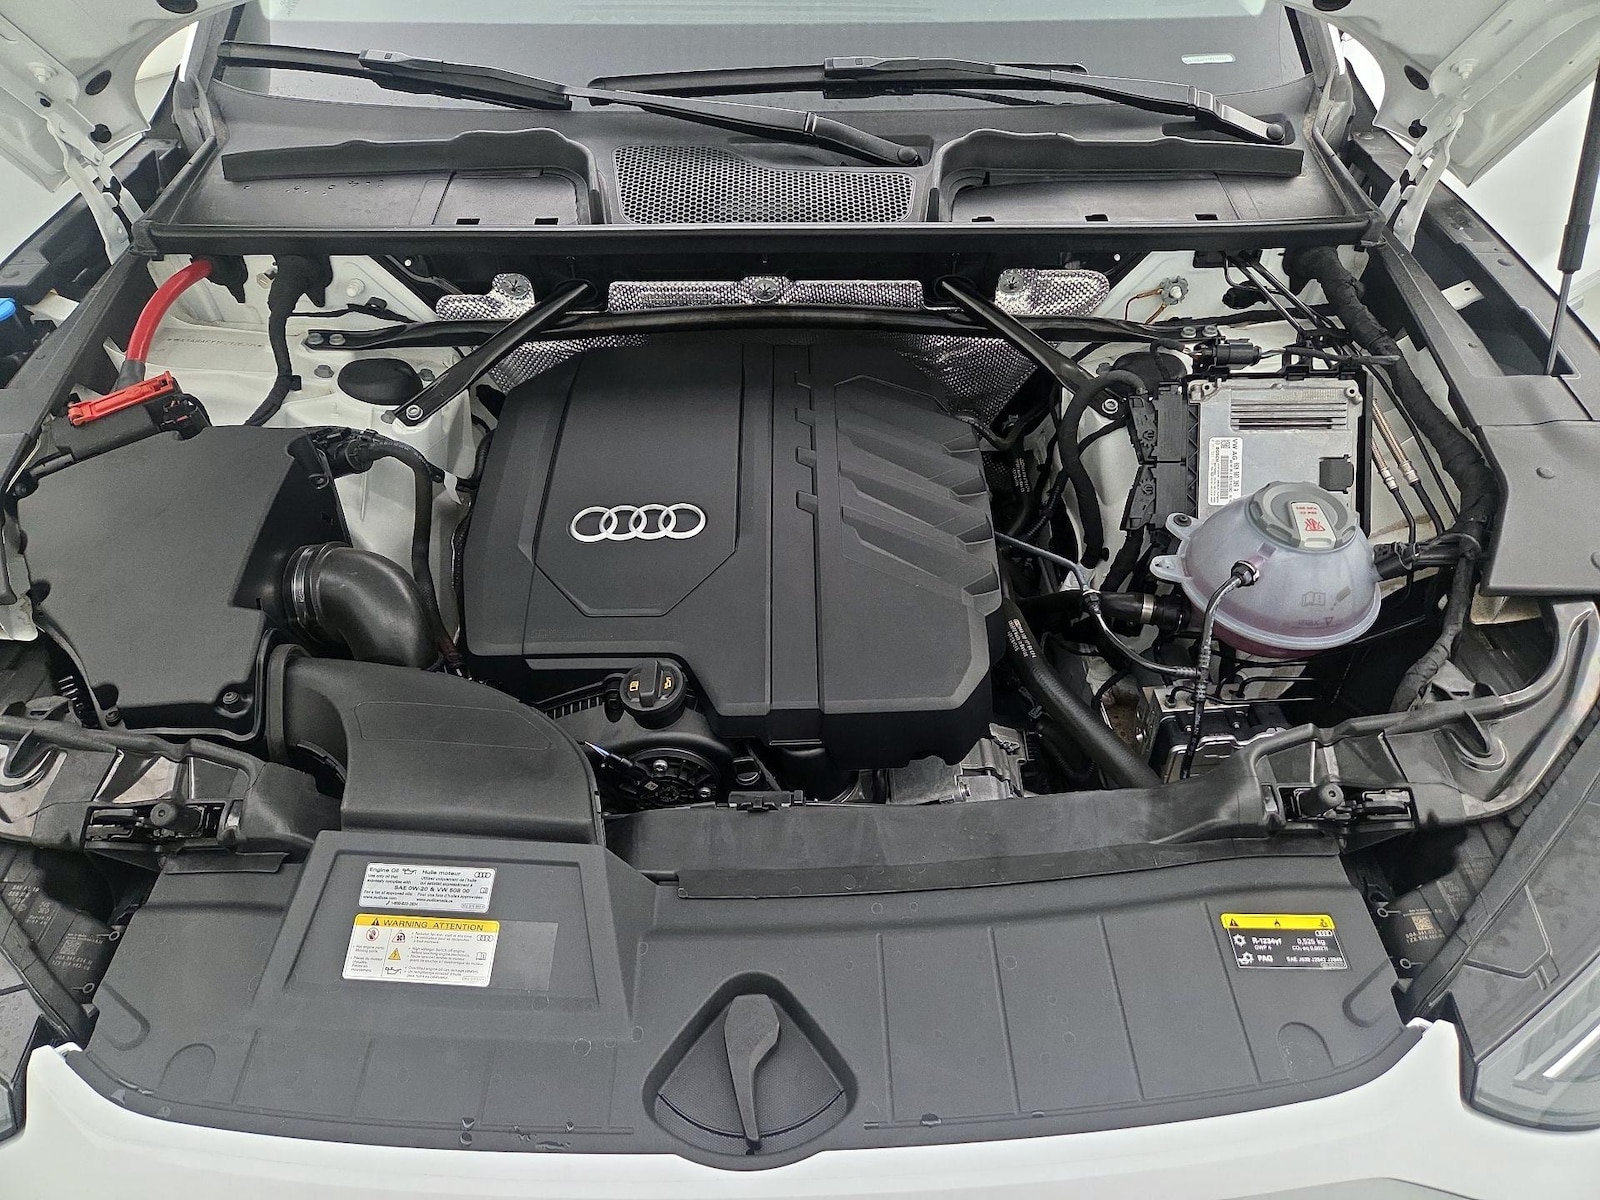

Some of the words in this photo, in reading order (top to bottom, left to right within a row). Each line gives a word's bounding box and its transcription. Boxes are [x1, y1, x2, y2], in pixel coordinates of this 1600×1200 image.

[1232, 438, 1238, 450] VW
[1232, 450, 1238, 460] AG
[384, 920, 428, 928] WARNING
[433, 922, 484, 931] ATTENTION
[1252, 937, 1282, 946] R-1234yf
